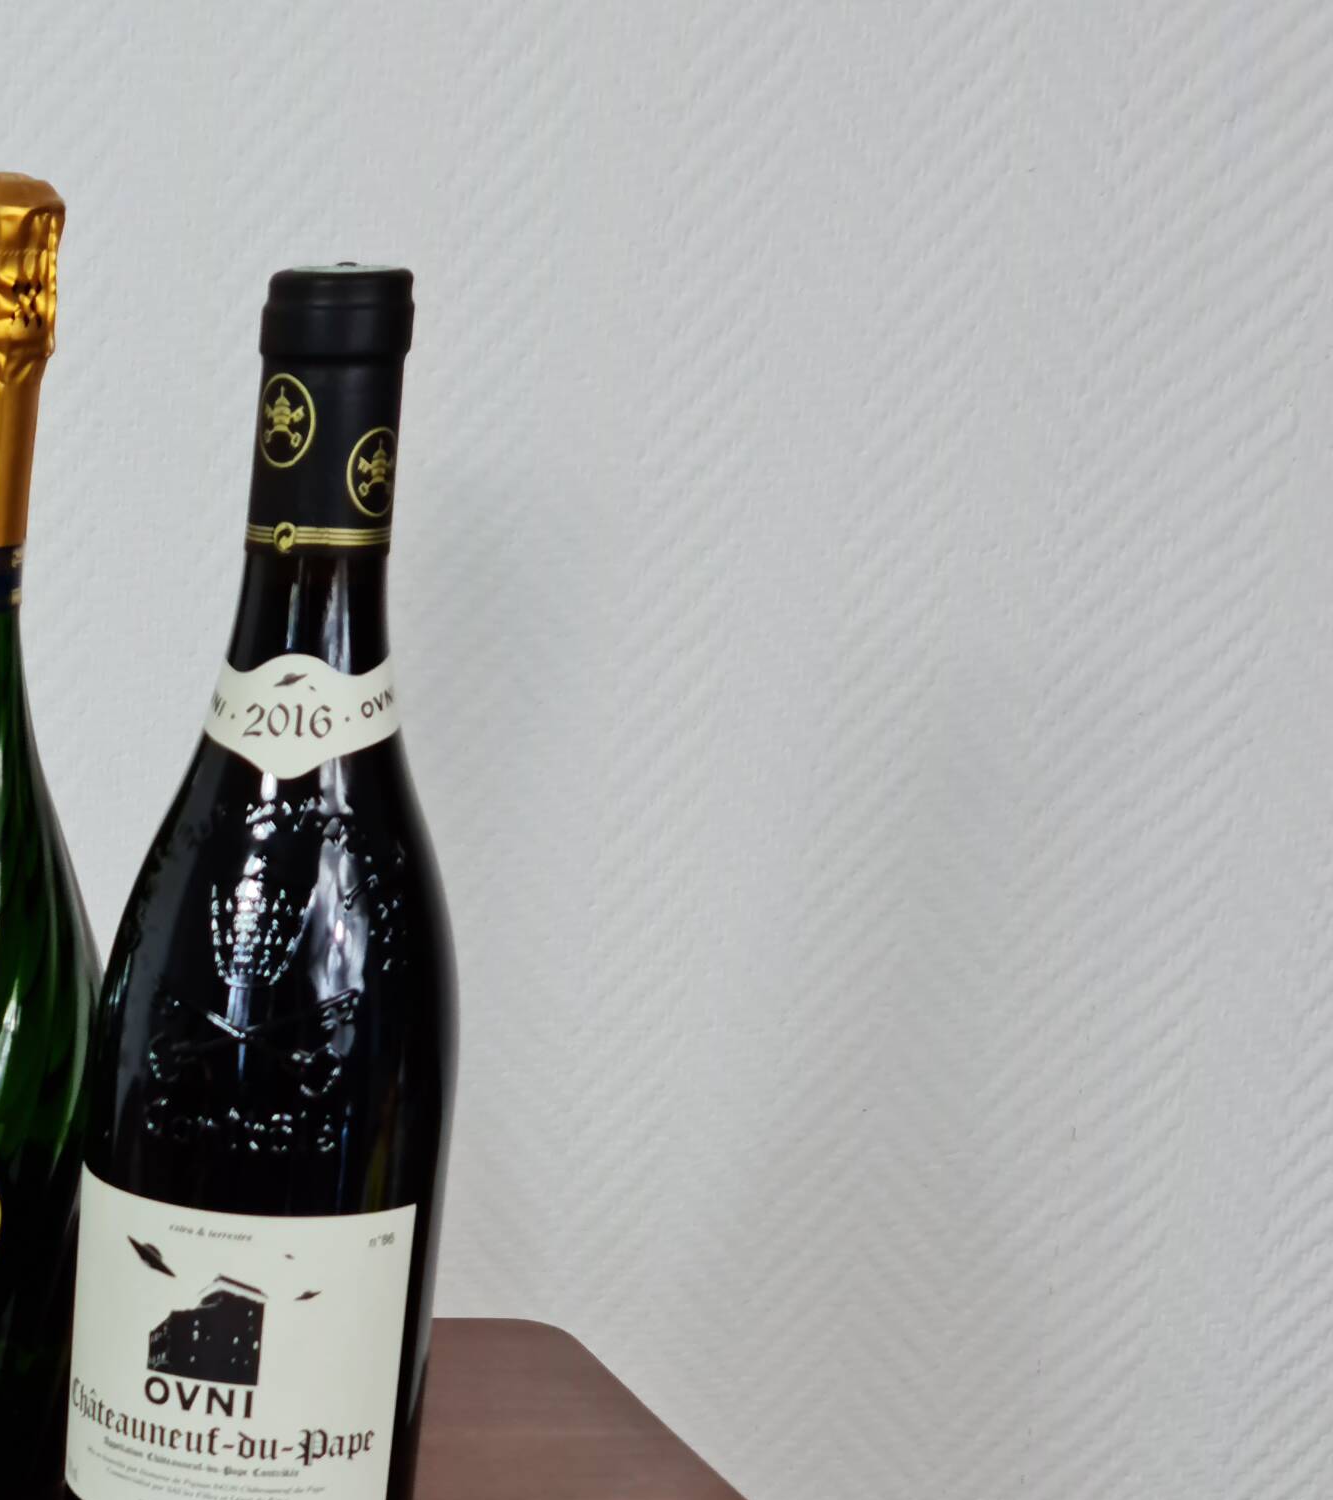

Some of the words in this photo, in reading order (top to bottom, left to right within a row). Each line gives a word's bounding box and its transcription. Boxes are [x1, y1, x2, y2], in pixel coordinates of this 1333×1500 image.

[243, 703, 332, 738] 2016
[144, 1376, 254, 1419] OVNI
[72, 1377, 375, 1466] Châteauneuf-du-Pape
